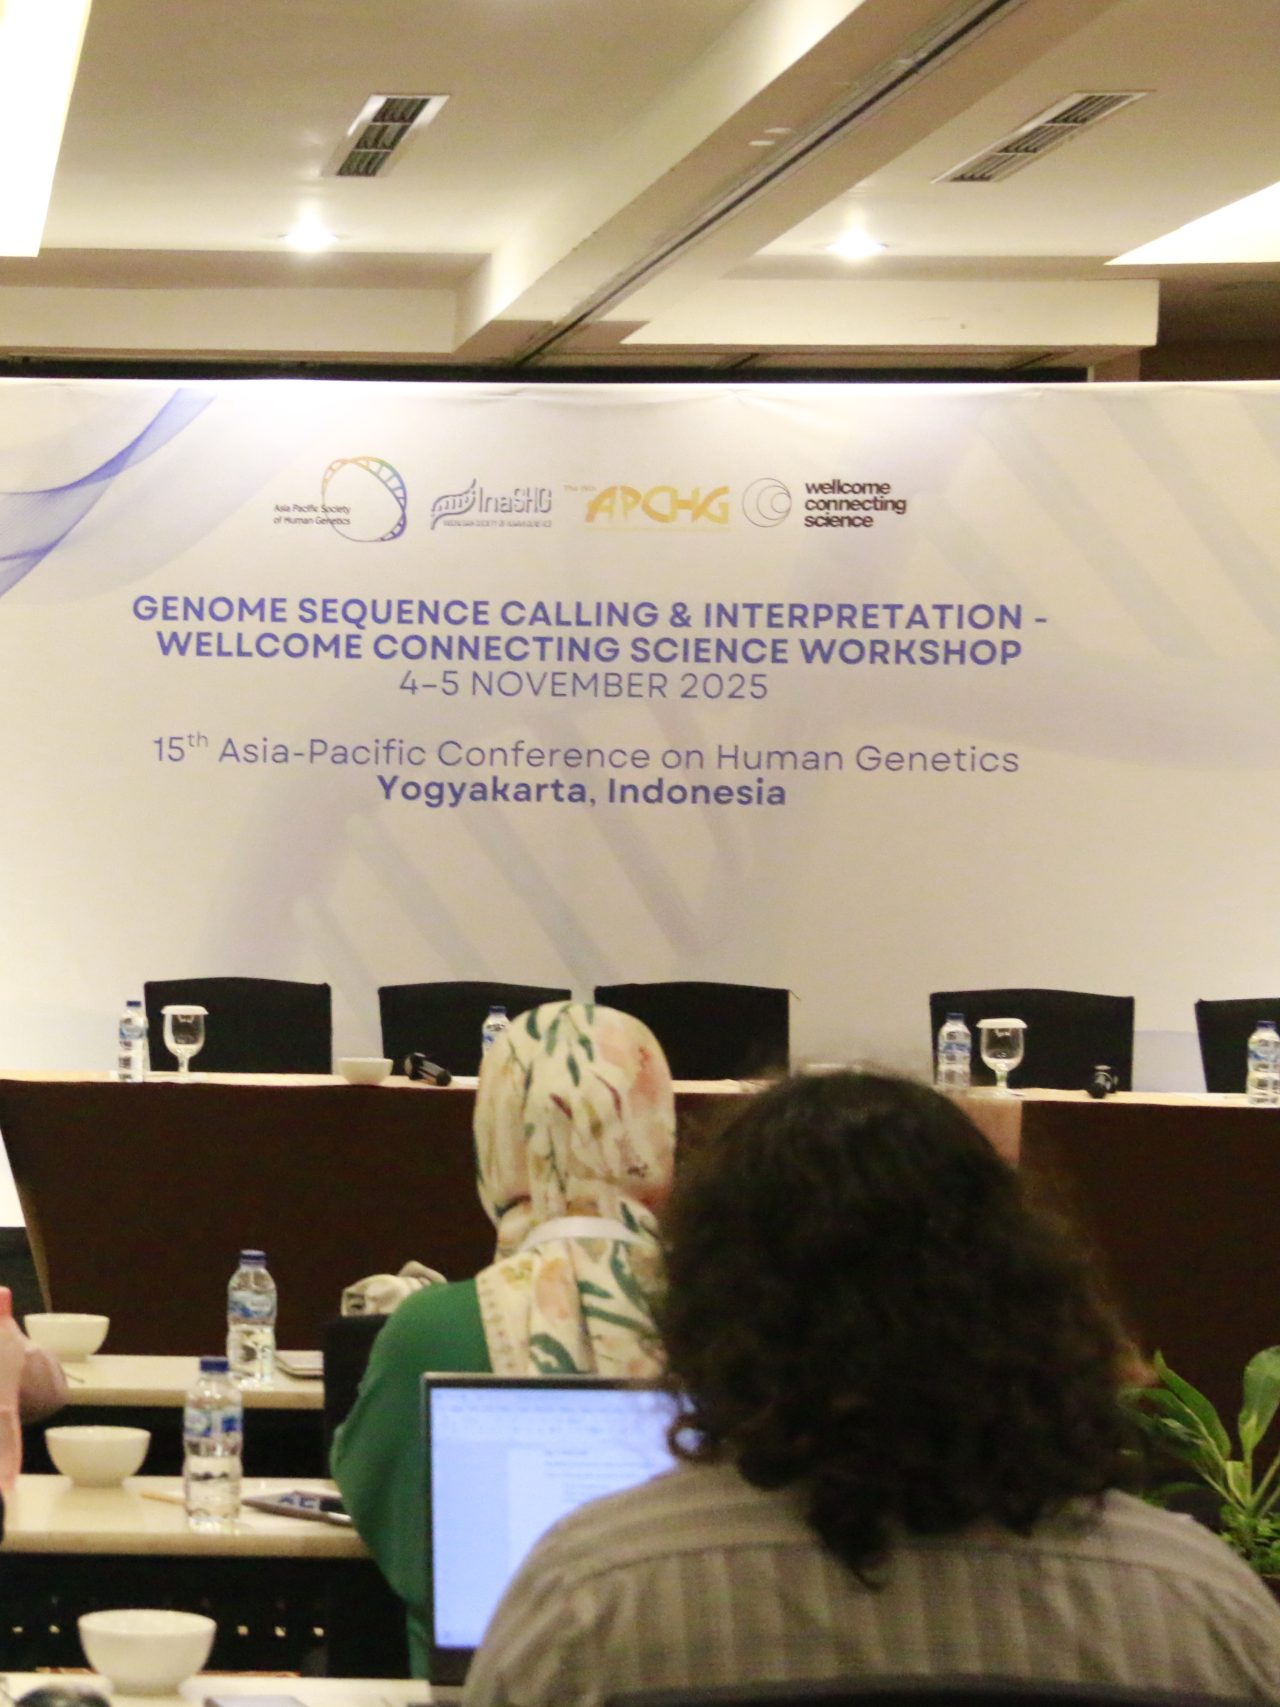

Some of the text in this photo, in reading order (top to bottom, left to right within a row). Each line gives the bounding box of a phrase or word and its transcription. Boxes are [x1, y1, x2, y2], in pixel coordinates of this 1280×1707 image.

[805, 479, 891, 495] wellcome
[804, 512, 874, 527] science
[805, 496, 907, 515] connecting
[133, 596, 287, 622] GENOME
[299, 598, 489, 630] SEQUENCE
[501, 601, 658, 627] CALLING
[670, 602, 691, 627] &
[705, 603, 1021, 629] INTERPRETATION
[157, 631, 1021, 665] WELLCOME CONNECTING SCIENCE WORKSHOP
[472, 671, 667, 698] NOVEMBER
[681, 673, 767, 699] 2025
[154, 732, 1019, 773] 15th Asia-Pacific Conference on Human Genetics
[378, 775, 785, 808] Yogyakarta, Indonesia
